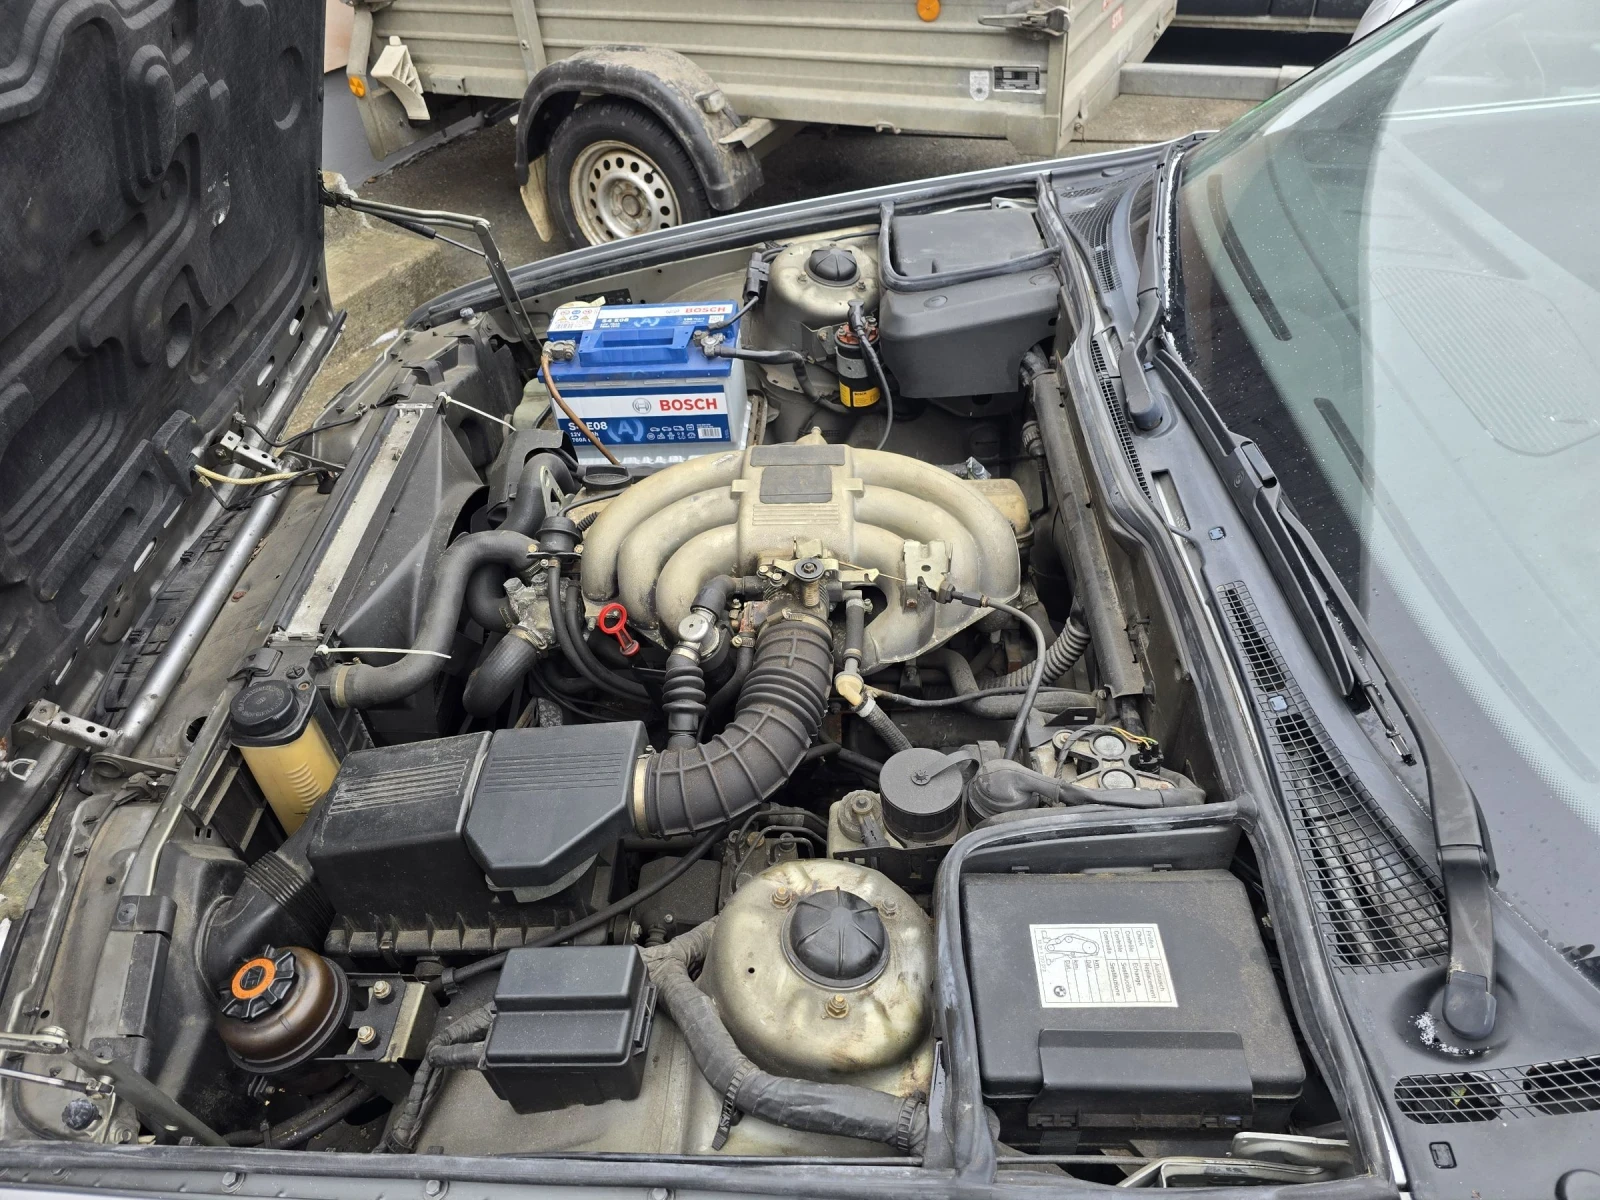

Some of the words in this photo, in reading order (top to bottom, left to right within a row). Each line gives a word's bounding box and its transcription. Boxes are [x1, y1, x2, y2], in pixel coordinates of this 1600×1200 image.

[685, 306, 726, 314] BOSCH
[659, 397, 719, 412] BOSCH
[568, 422, 580, 431] S
[586, 421, 608, 431] E08
[1136, 930, 1145, 947] Check
[1132, 962, 1142, 987] Echange
[1144, 962, 1157, 999] Replacement
[1154, 962, 1166, 992] Austausch
